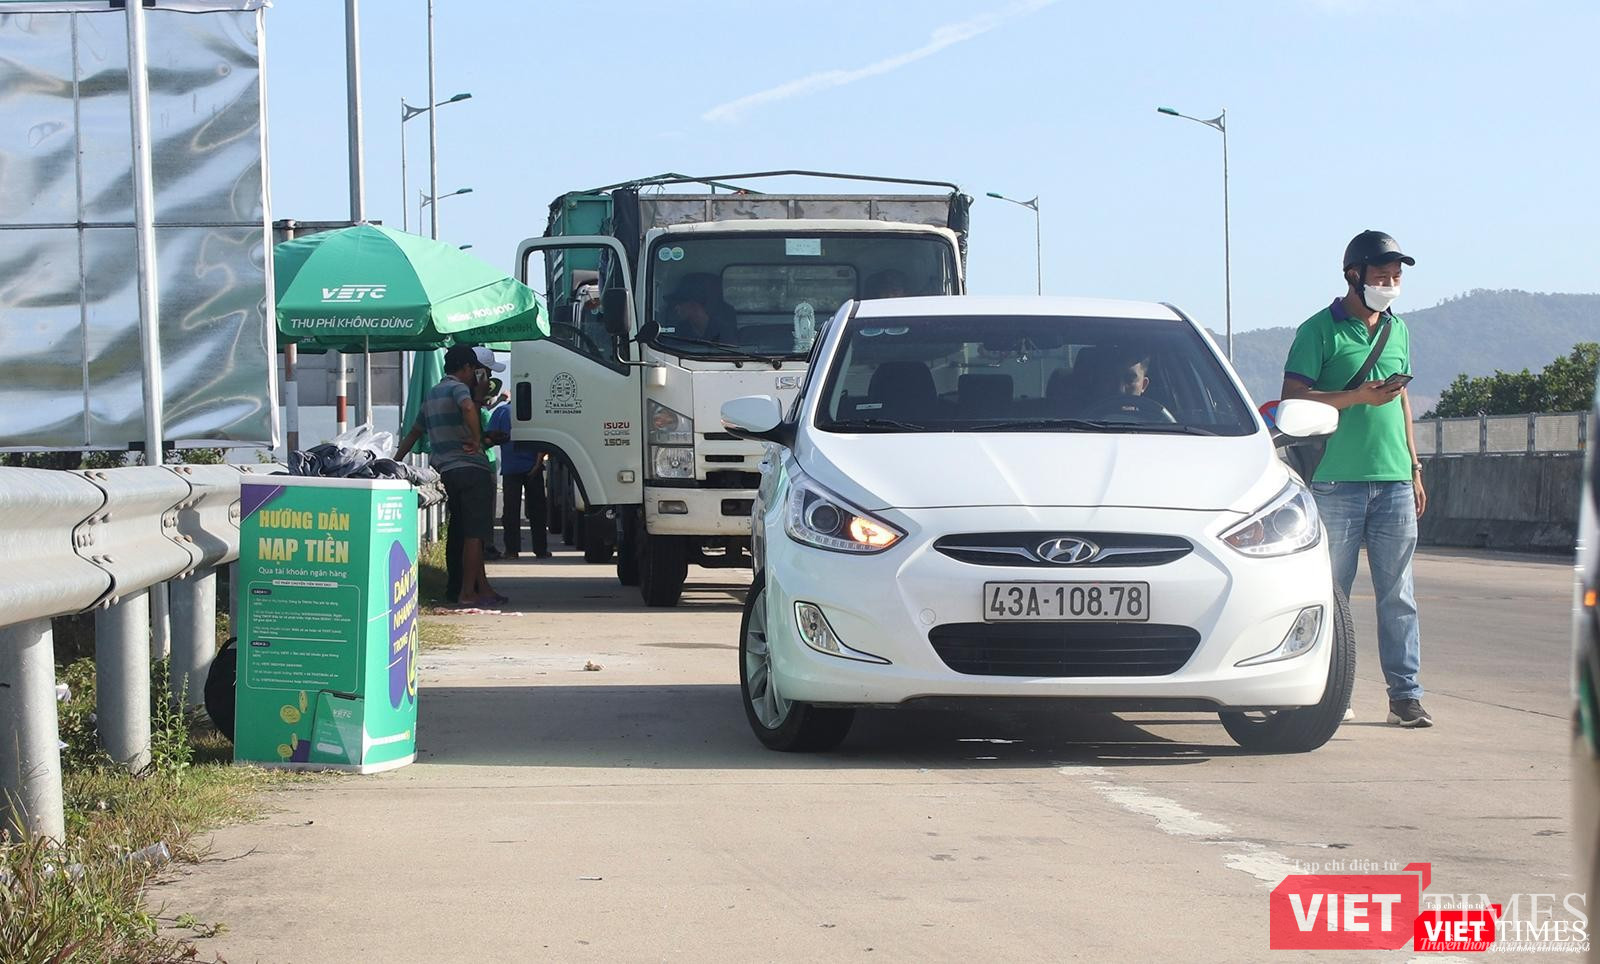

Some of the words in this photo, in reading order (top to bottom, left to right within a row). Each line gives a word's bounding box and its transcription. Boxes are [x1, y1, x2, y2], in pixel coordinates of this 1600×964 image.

[321, 285, 387, 302] VETC
[291, 319, 315, 329] THU
[316, 315, 336, 328] PHÍ
[338, 315, 379, 328] KHÔNG
[380, 315, 415, 328] DỪNG
[604, 421, 630, 429] ISUZU
[259, 508, 313, 530] HƯỚNG
[318, 507, 350, 531] DẪN
[258, 537, 299, 565] NẠP
[304, 533, 350, 564] TIỀN
[258, 566, 274, 575] Qua
[394, 569, 410, 604] DÁN
[990, 587, 1143, 616] 43A-108.78
